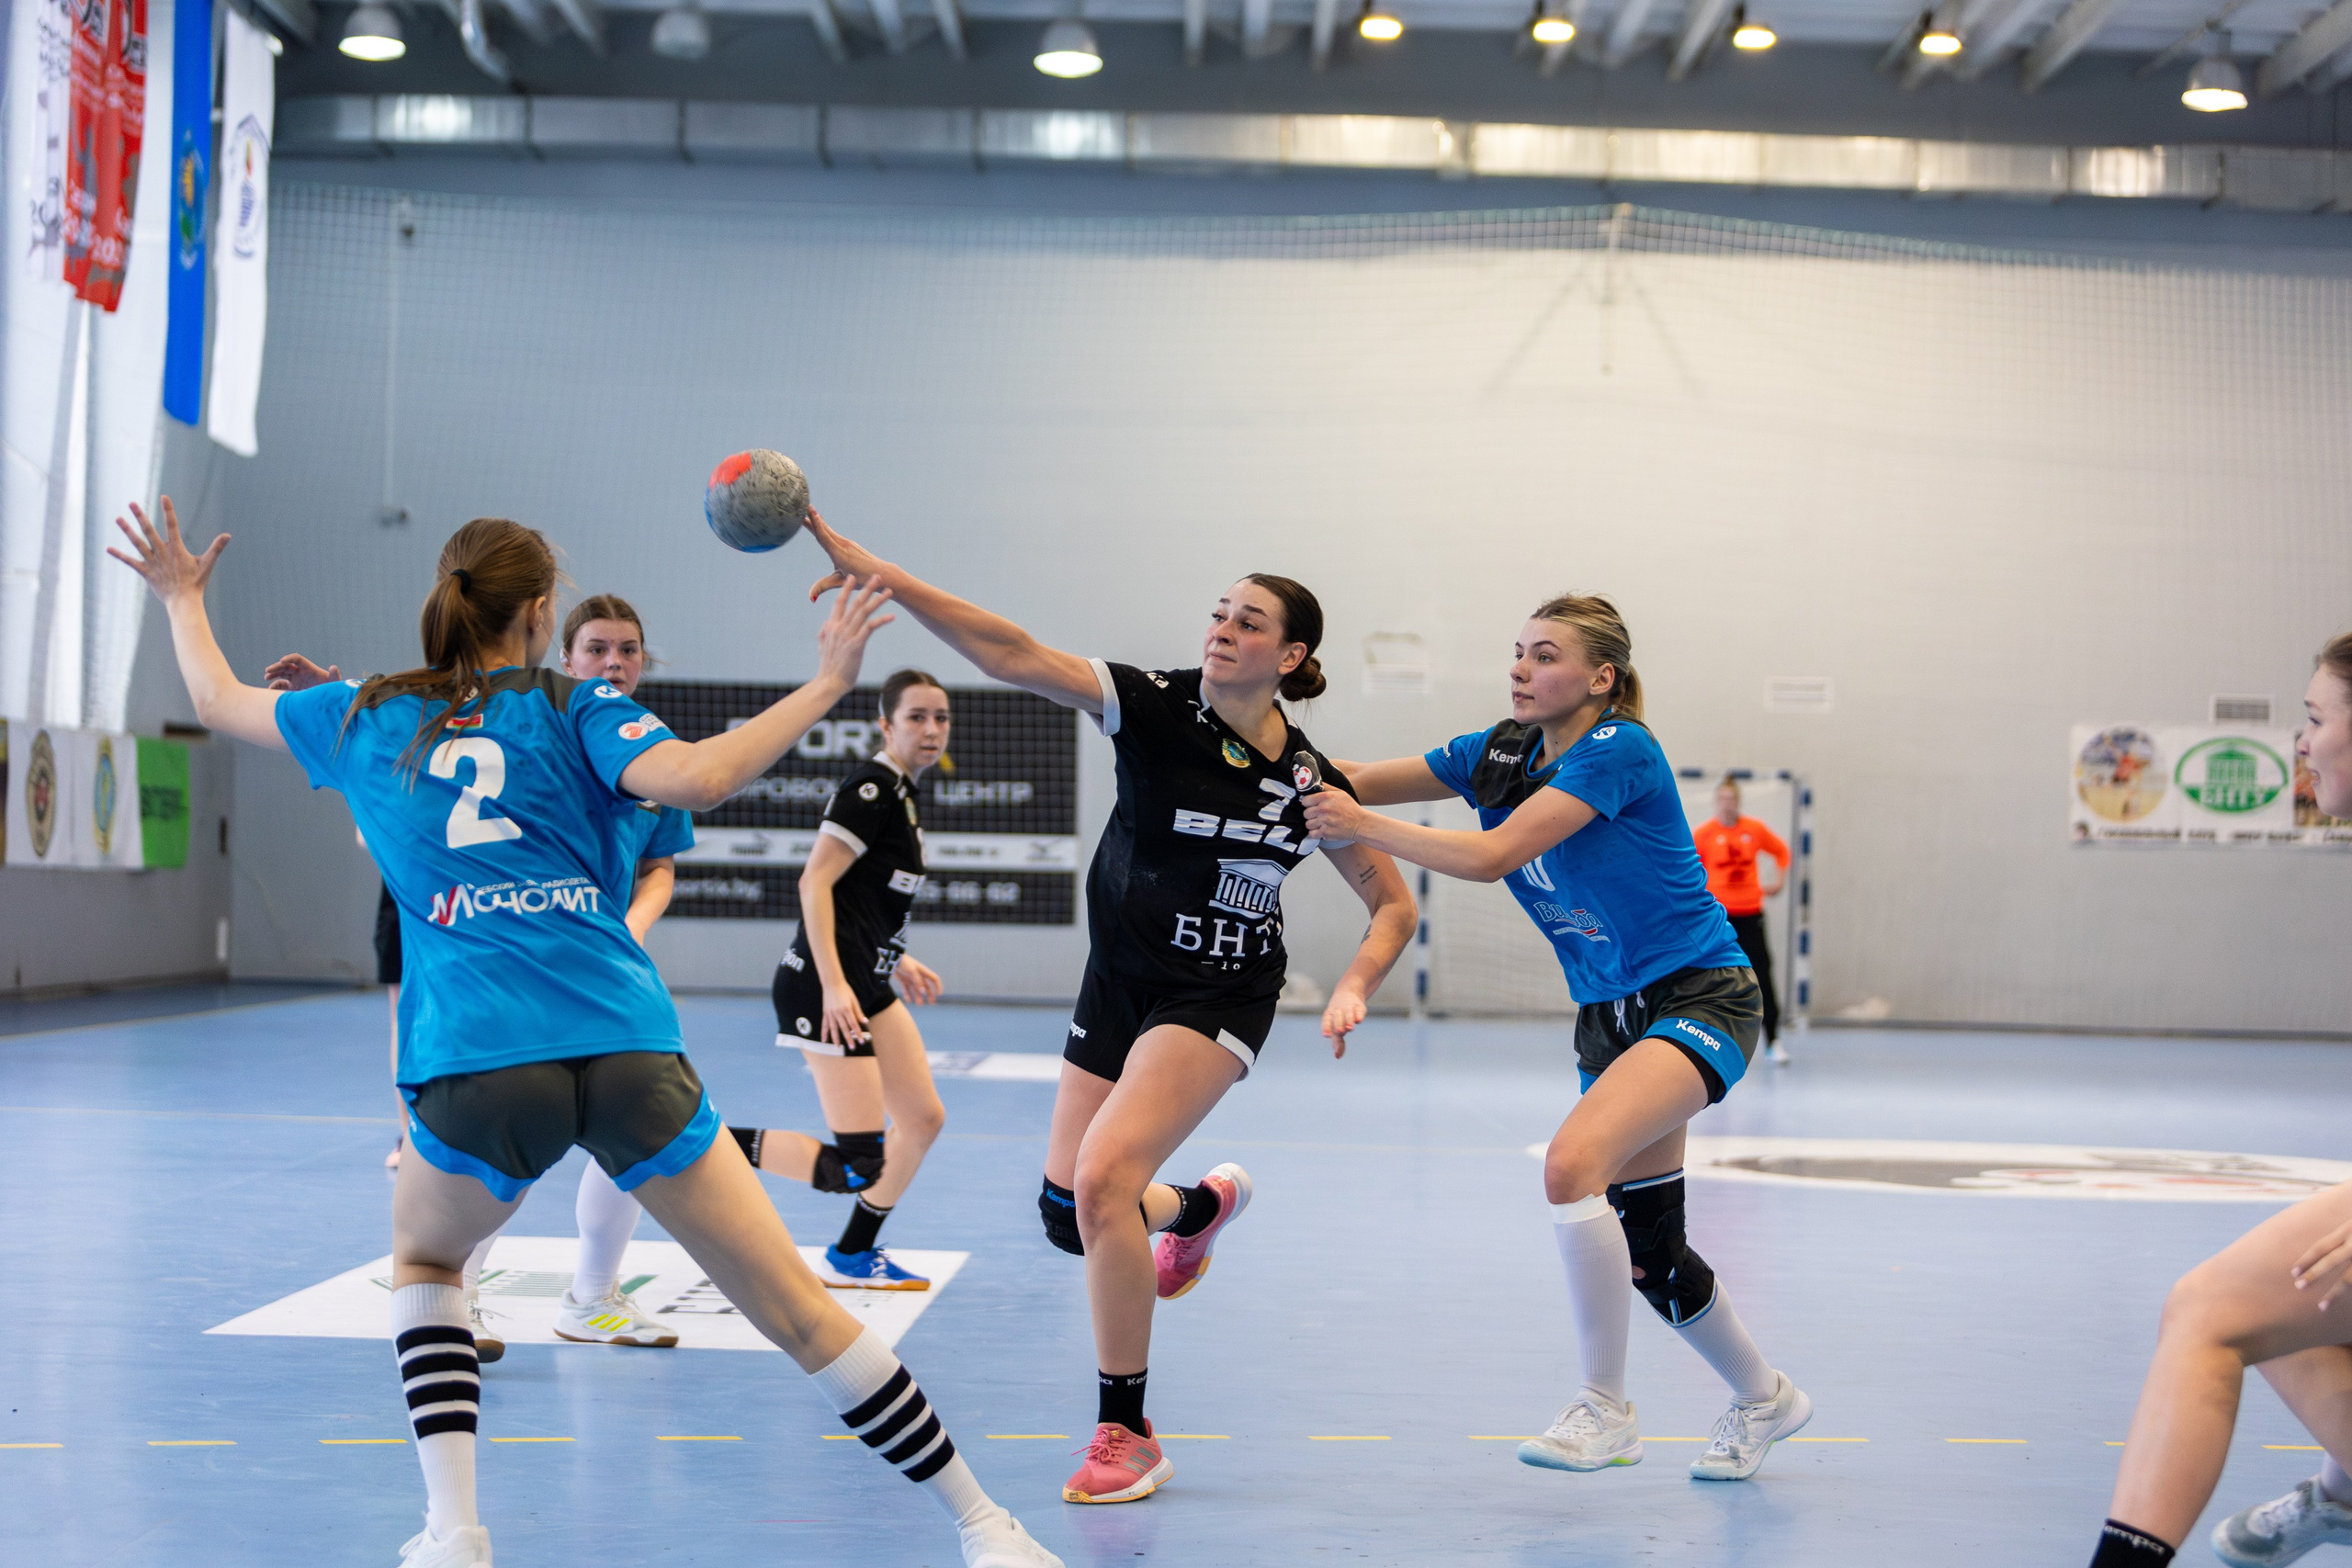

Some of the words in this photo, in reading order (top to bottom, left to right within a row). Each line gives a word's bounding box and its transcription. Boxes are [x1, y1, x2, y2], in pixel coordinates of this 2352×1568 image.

[428, 736, 523, 849] 2
[933, 781, 1034, 807] ЦЕНТР
[1676, 1019, 1721, 1051] Kempa
